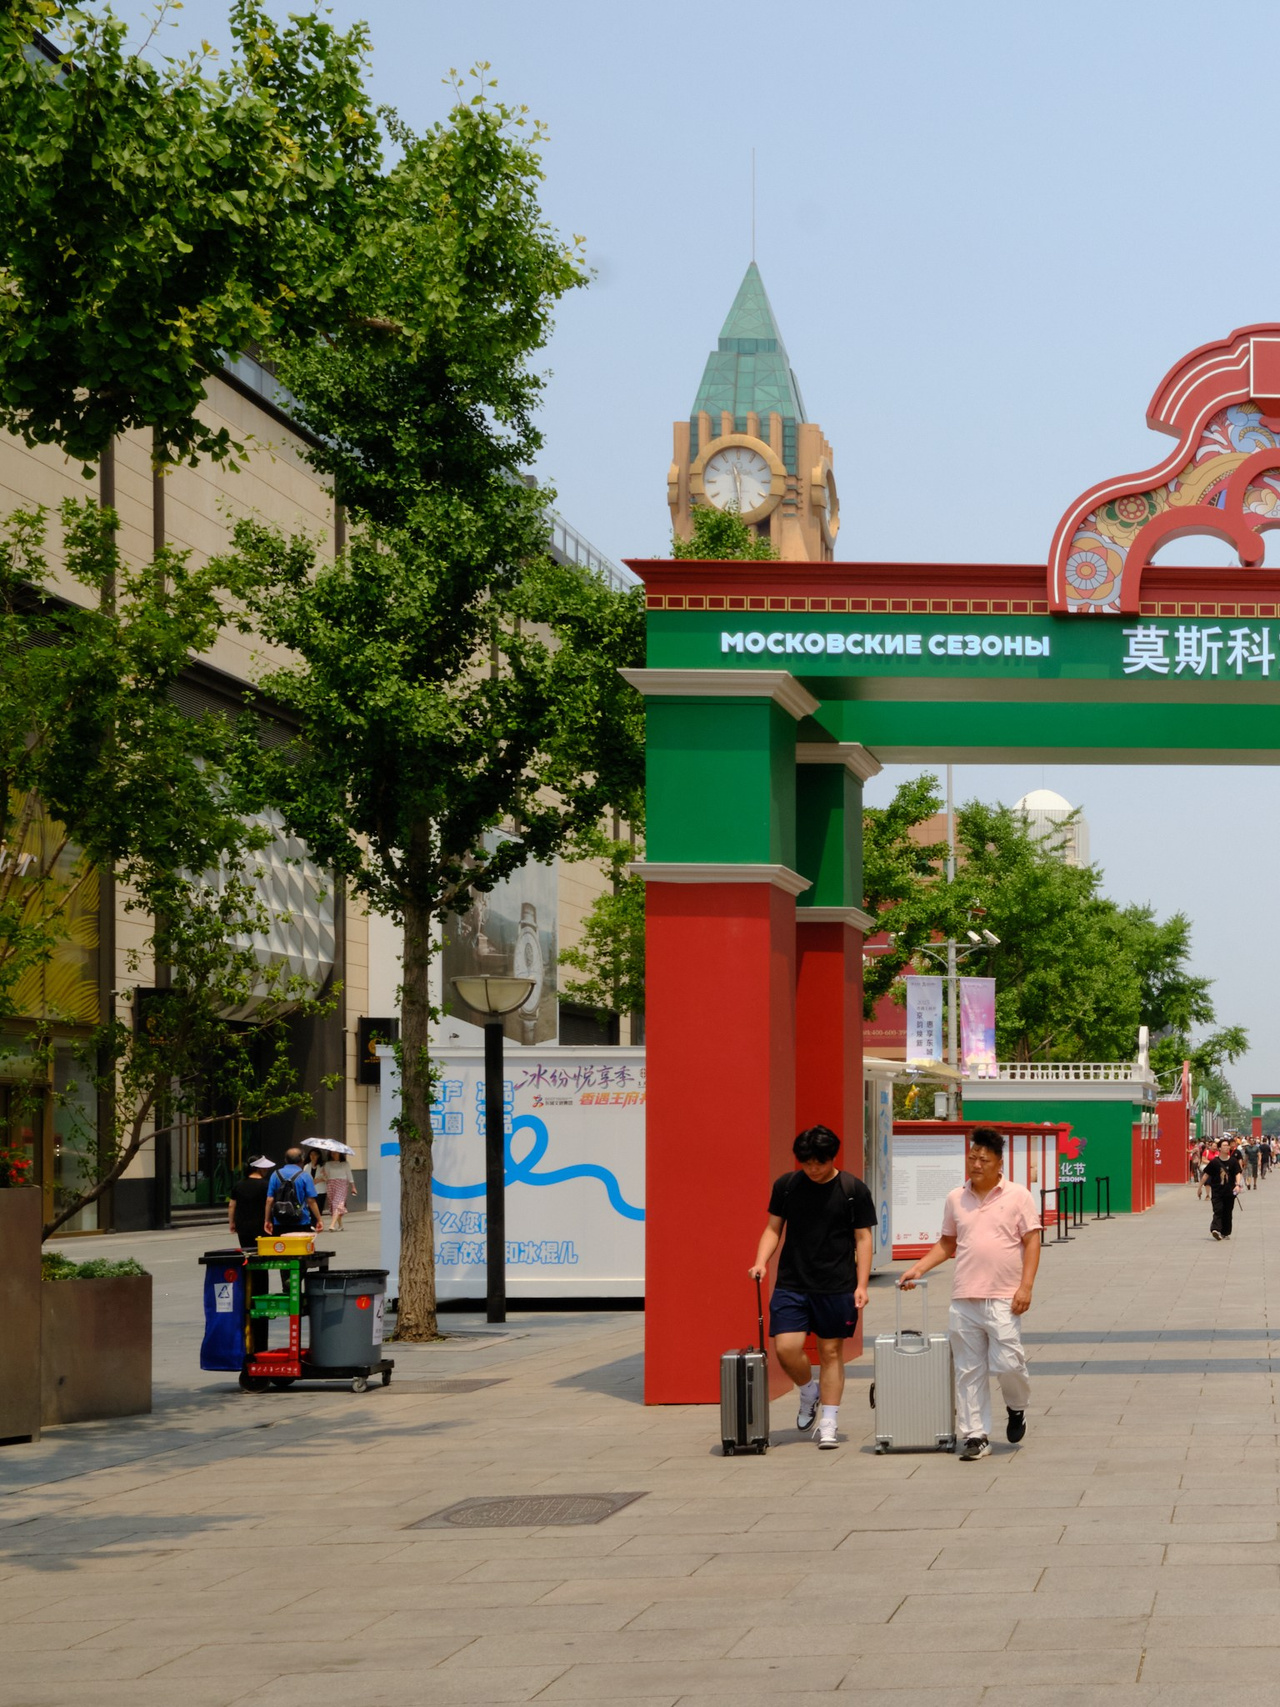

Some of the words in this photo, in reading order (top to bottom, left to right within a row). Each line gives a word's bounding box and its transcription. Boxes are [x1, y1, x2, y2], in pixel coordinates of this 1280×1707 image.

[720, 632, 922, 654] МОСКОВСКИЕ
[928, 634, 1050, 656] СЕЗОНЫ
[1059, 1163, 1086, 1176] 化节
